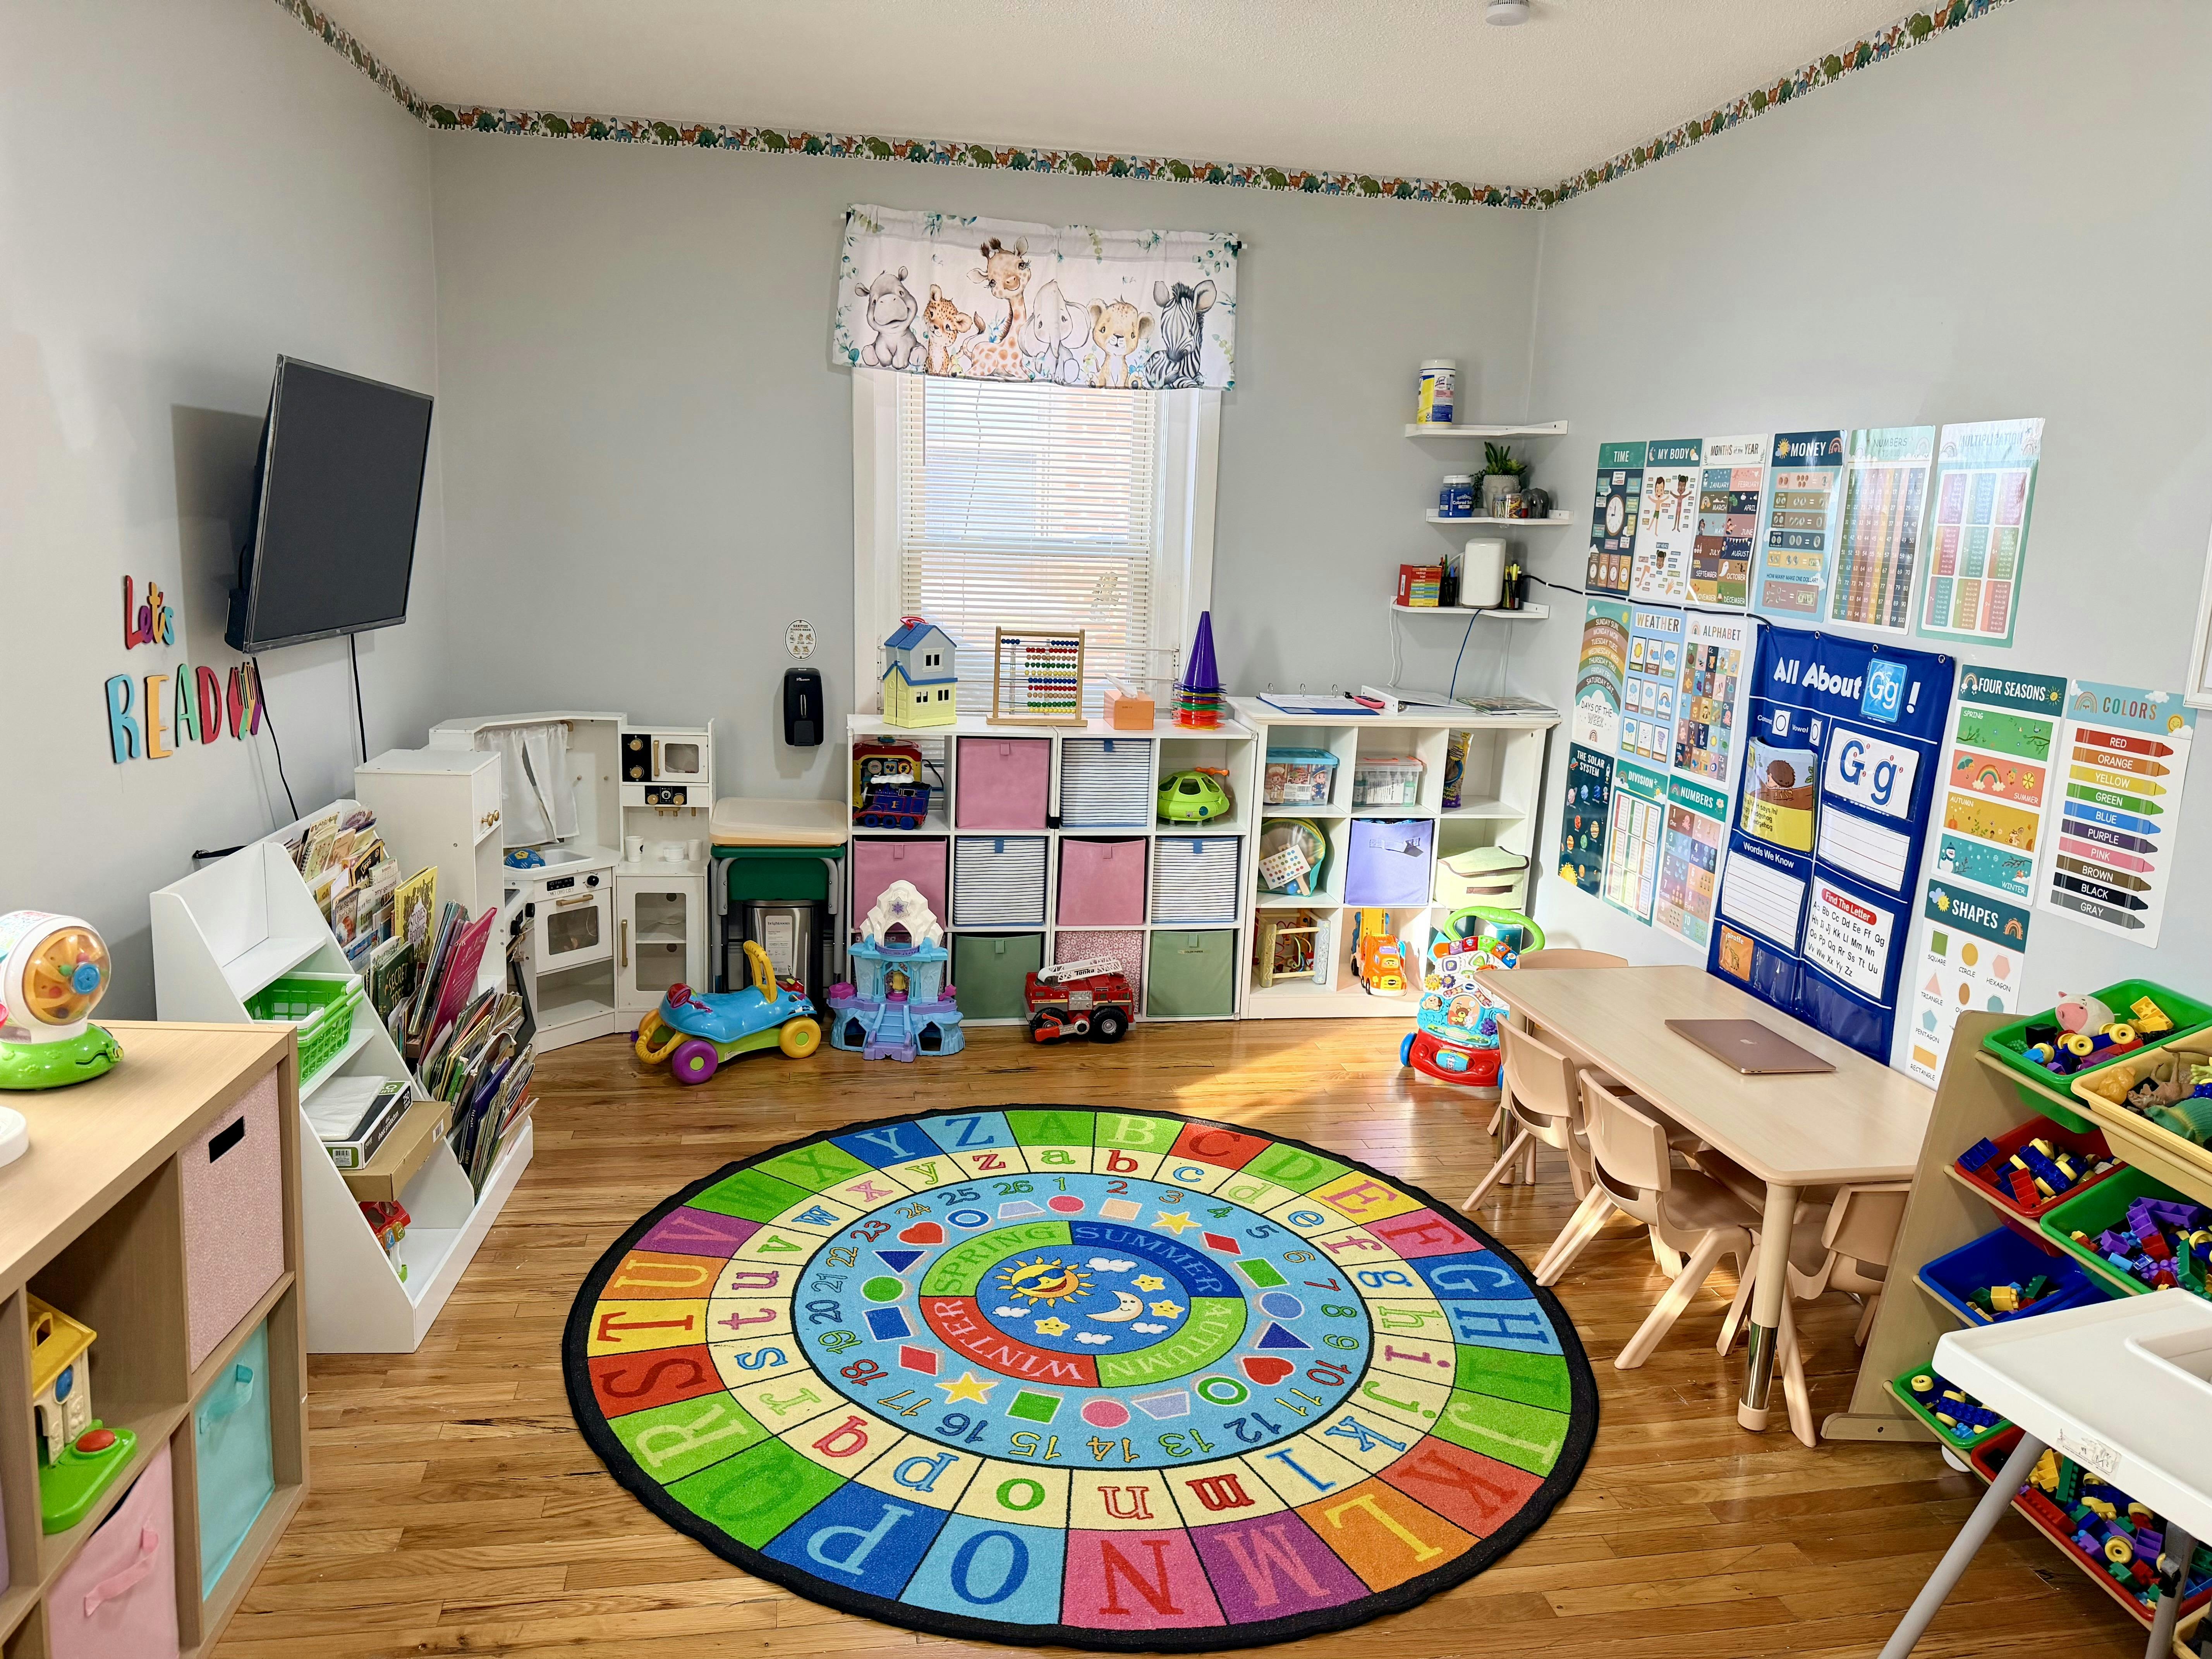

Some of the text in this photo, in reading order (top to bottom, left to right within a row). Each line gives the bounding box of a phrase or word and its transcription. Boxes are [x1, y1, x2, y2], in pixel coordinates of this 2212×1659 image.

[1711, 444, 1732, 456] MONTHS
[1745, 443, 1758, 455] YEAR
[1790, 441, 1826, 457] MONEY
[1873, 438, 1907, 447] NUMBERS
[1614, 451, 1628, 462] TIME
[1658, 448, 1689, 459] MY BODY
[1695, 570, 1717, 578] SEPTEMBER
[124, 575, 175, 649] Let's
[1595, 619, 1610, 627] SUNDAY
[1637, 613, 1679, 632] WEATHER
[1593, 628, 1609, 637] MONDAY
[1703, 625, 1741, 641] ALPHABET
[1588, 647, 1610, 656] WEDNESDAY
[1589, 657, 1608, 665] THURSDAY
[1591, 667, 1604, 675] FRIDAY
[1586, 677, 1606, 685] SATURDAY
[1773, 657, 1921, 713] All About Gg !
[1978, 678, 2045, 701] FOUR SEASONS
[105, 664, 222, 763] READ
[1581, 701, 1594, 711] DAYS
[1603, 708, 1613, 718] THE
[1963, 710, 1983, 720] SPRING
[2103, 697, 2157, 720] COLORS
[1588, 714, 1604, 727] WEEK
[1792, 724, 1808, 734] Vowel
[2110, 738, 2127, 748] RED
[1577, 750, 1604, 768] THE SOLAR
[2097, 754, 2133, 769] ORANGE
[1580, 764, 1599, 777] SYSTEM
[1628, 771, 1653, 788] DIVISION
[2095, 773, 2130, 788] YELLOW
[1680, 787, 1713, 808] NUMBERS
[1950, 797, 1973, 807] AUTUMN
[2013, 792, 2039, 804] SUMMER
[2095, 792, 2123, 806] GREEN
[1760, 805, 1771, 813] says
[2095, 811, 2117, 824] BLUE
[2088, 829, 2119, 845] PURPLE
[1743, 841, 1794, 869] Words We Know
[2091, 848, 2109, 861] PINK
[2082, 866, 2113, 882] BROWN
[2002, 881, 2025, 894] WINTER
[2081, 884, 2108, 899] BLACK
[1825, 891, 1870, 921] Find The Letter
[2080, 902, 2103, 916] GRAY
[1951, 900, 1998, 929] SHAPES
[1813, 901, 1885, 947] Aa Bb Cc Dd Ee Ff Gg
[1726, 932, 1744, 945] giraffe
[1812, 915, 1875, 957] Hh Ii Jj Kk Ll Mm Nn
[1808, 942, 1852, 977] Vv Ww Xx Yy Zz
[1810, 929, 1878, 974] Oo Pp Qq Rr Ss Tt Uu
[1928, 955, 1946, 966] SQUARE
[389, 963, 408, 995] SECRET
[1959, 967, 1975, 977] CIRCLE
[1986, 978, 2011, 992] HEXAGON
[1921, 992, 1943, 1006] TRIANGLE
[1915, 1028, 1939, 1043] PENTAGON
[1910, 1064, 1935, 1081] RECTANGLE
[945, 1116, 994, 1147] Z
[1111, 1114, 1154, 1145] B
[1188, 1130, 1238, 1158] C
[1321, 1180, 1397, 1214] E
[935, 1226, 1057, 1293] SPRING
[1075, 1226, 1223, 1293] SUMMER
[613, 1259, 709, 1292] U
[1430, 1264, 1516, 1293] G
[597, 1312, 694, 1343] T
[934, 1300, 1081, 1382] WINTER
[1106, 1302, 1234, 1378] AUTUMN
[598, 1358, 707, 1397] S
[1324, 1494, 1443, 1562] L
[807, 1504, 915, 1576] P
[950, 1530, 1029, 1605] O
[1099, 1539, 1183, 1615] N
